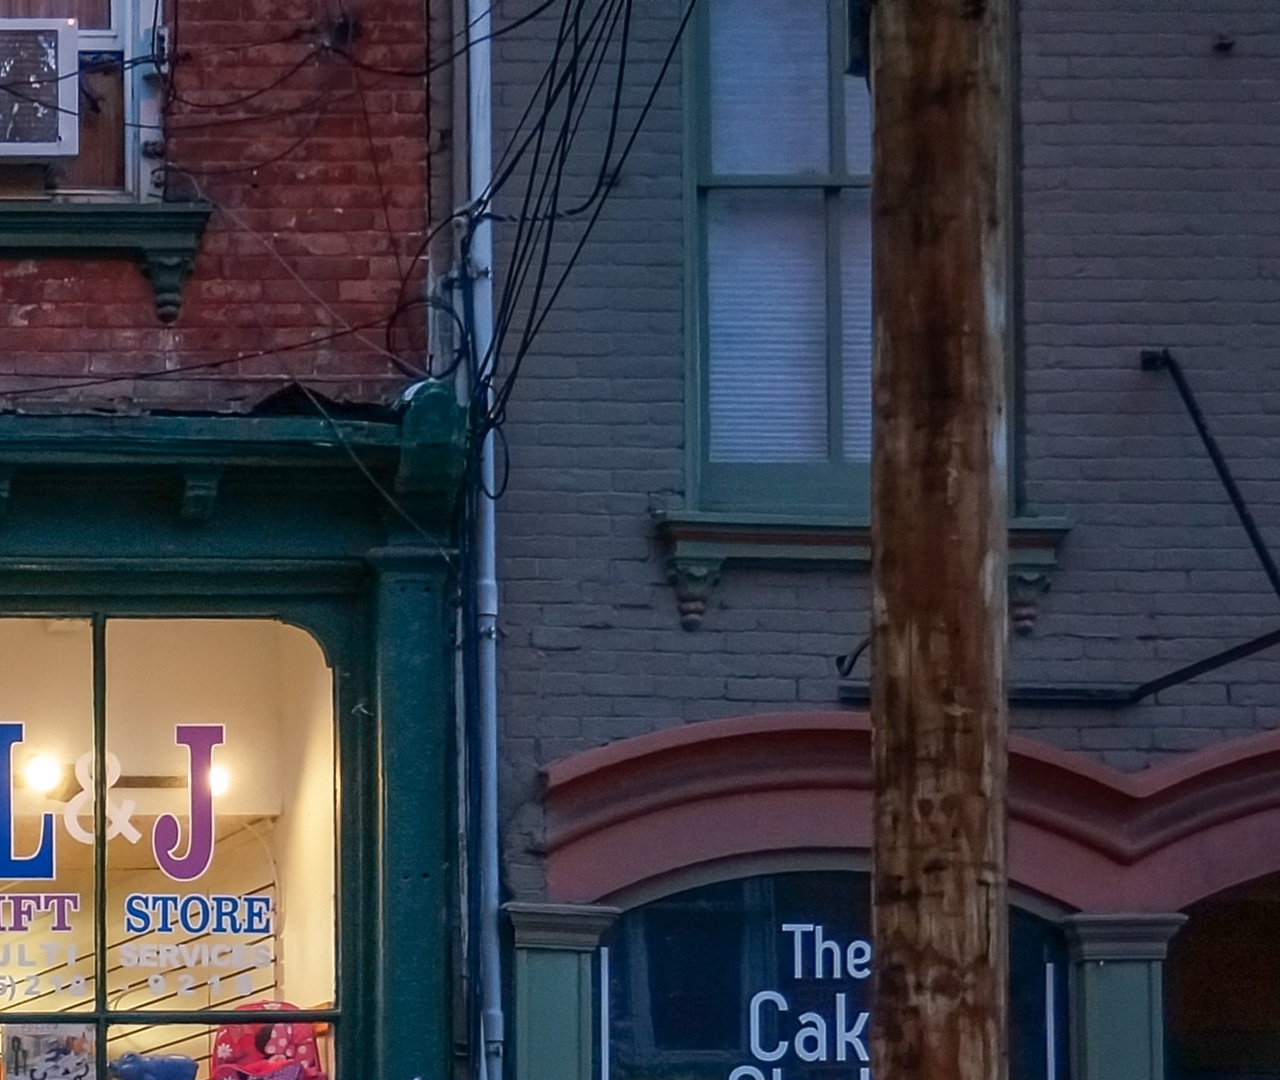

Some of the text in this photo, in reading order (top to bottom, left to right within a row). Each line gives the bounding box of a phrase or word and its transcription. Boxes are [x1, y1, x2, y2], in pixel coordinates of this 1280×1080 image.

[124, 893, 274, 935] STORE
[120, 944, 272, 968] SERVICES
[782, 923, 872, 979] The
[749, 990, 870, 1062] Cak
